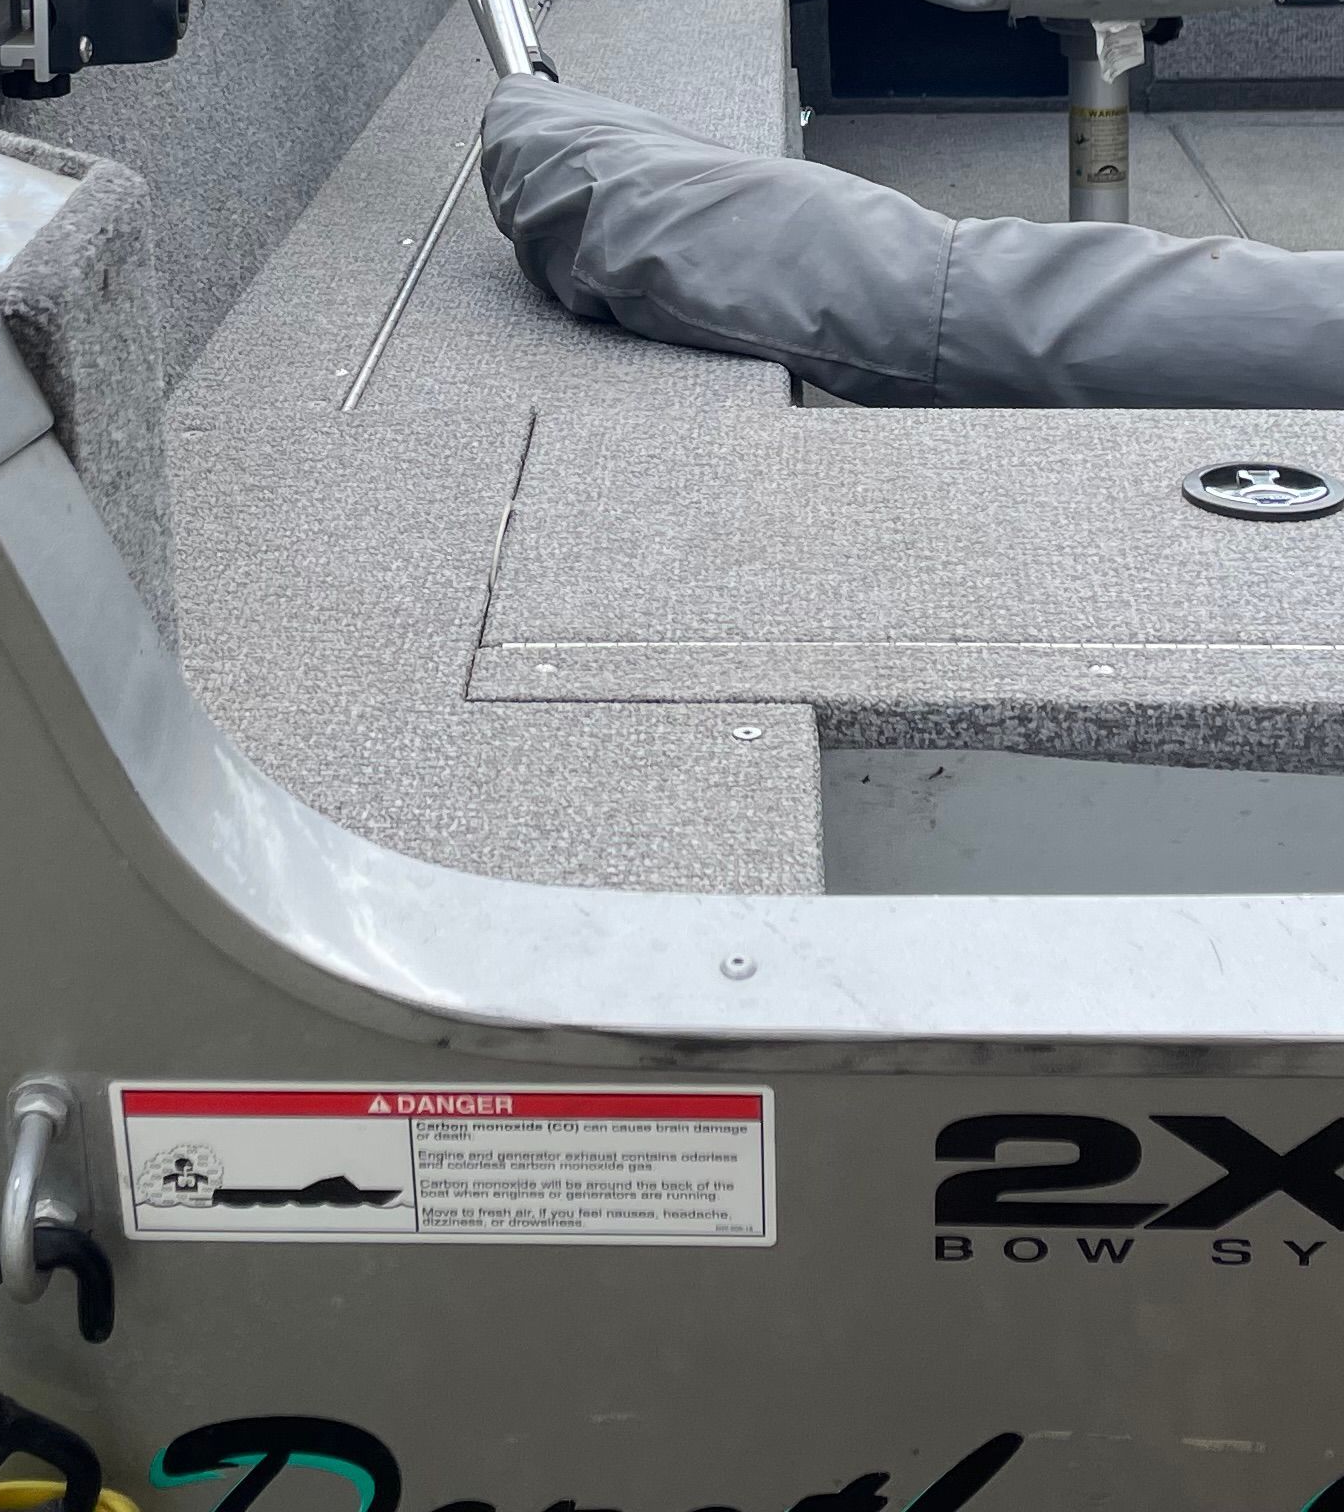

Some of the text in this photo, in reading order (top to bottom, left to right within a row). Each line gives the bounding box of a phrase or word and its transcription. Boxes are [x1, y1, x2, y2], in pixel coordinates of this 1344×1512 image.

[396, 1095, 514, 1115] DANGER
[416, 1121, 748, 1136] Carbon monoxide (CO) can cause brain damage
[418, 1151, 738, 1163] Engine and generator exhaust contains odorless
[419, 1161, 443, 1170] and
[447, 1161, 506, 1170] colorless
[510, 1161, 555, 1171] carbon
[559, 1162, 624, 1171] monoxide
[420, 1179, 734, 1191] Carbon monoxide will be around the back of the
[420, 1190, 450, 1198] boat
[453, 1190, 489, 1198] when
[493, 1190, 545, 1200] engines
[549, 1191, 562, 1199] or
[565, 1191, 637, 1201] generators
[641, 1192, 662, 1200] are
[422, 1208, 458, 1218] Move
[462, 1208, 475, 1218] to
[478, 1208, 512, 1218] fresh
[550, 1209, 575, 1220] you
[578, 1208, 602, 1218] feel
[491, 1219, 504, 1227] or
[935, 1235, 1135, 1264] BOW
